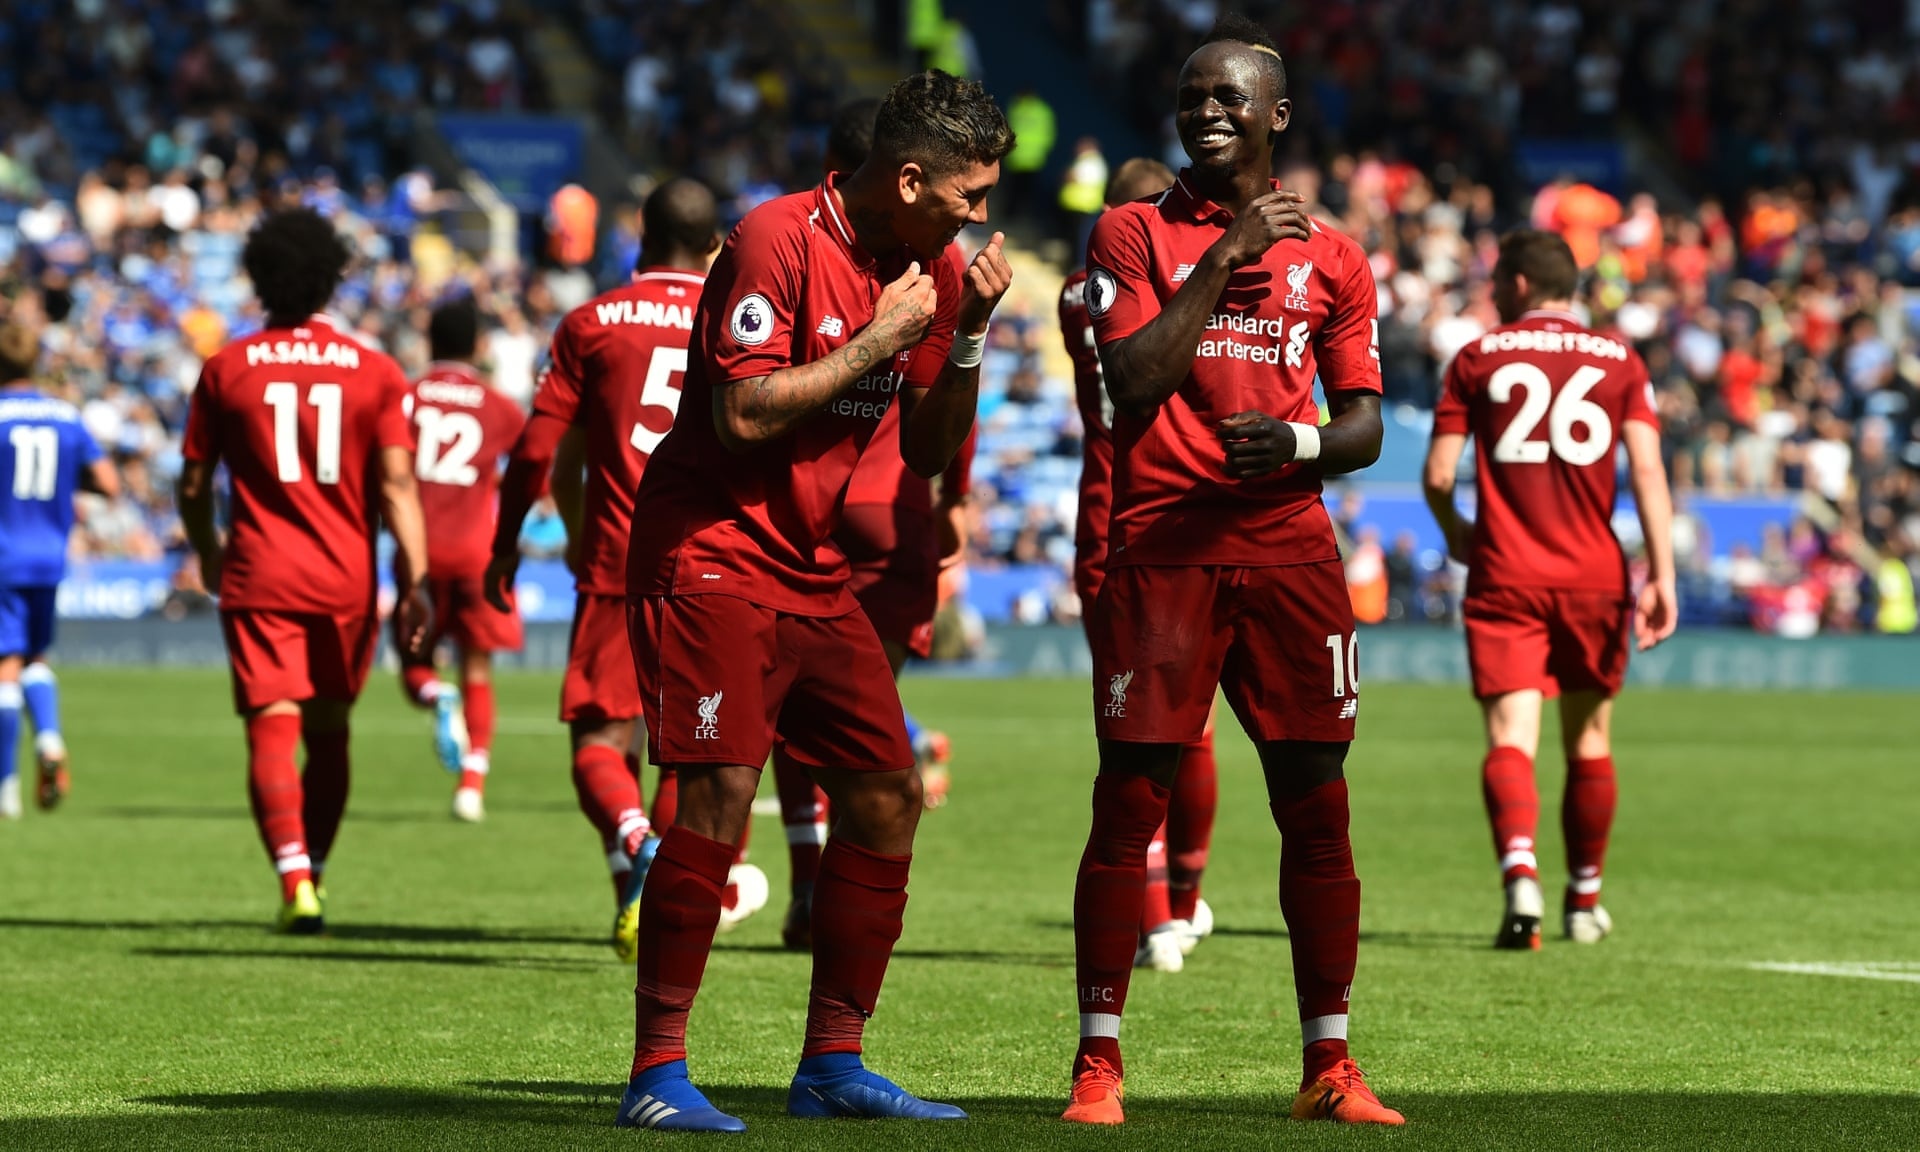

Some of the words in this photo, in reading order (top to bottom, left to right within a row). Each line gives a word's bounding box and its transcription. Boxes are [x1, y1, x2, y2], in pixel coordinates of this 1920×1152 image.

[596, 300, 694, 330] WIJNAL
[1196, 337, 1281, 365] artered
[1205, 312, 1284, 338] andard
[1481, 330, 1628, 361] ROBERTSON
[263, 381, 343, 485] 11
[629, 346, 689, 456] 5
[1488, 361, 1613, 466] 26
[9, 424, 59, 501] 11
[414, 405, 484, 487] 12
[1326, 630, 1360, 697] 10
